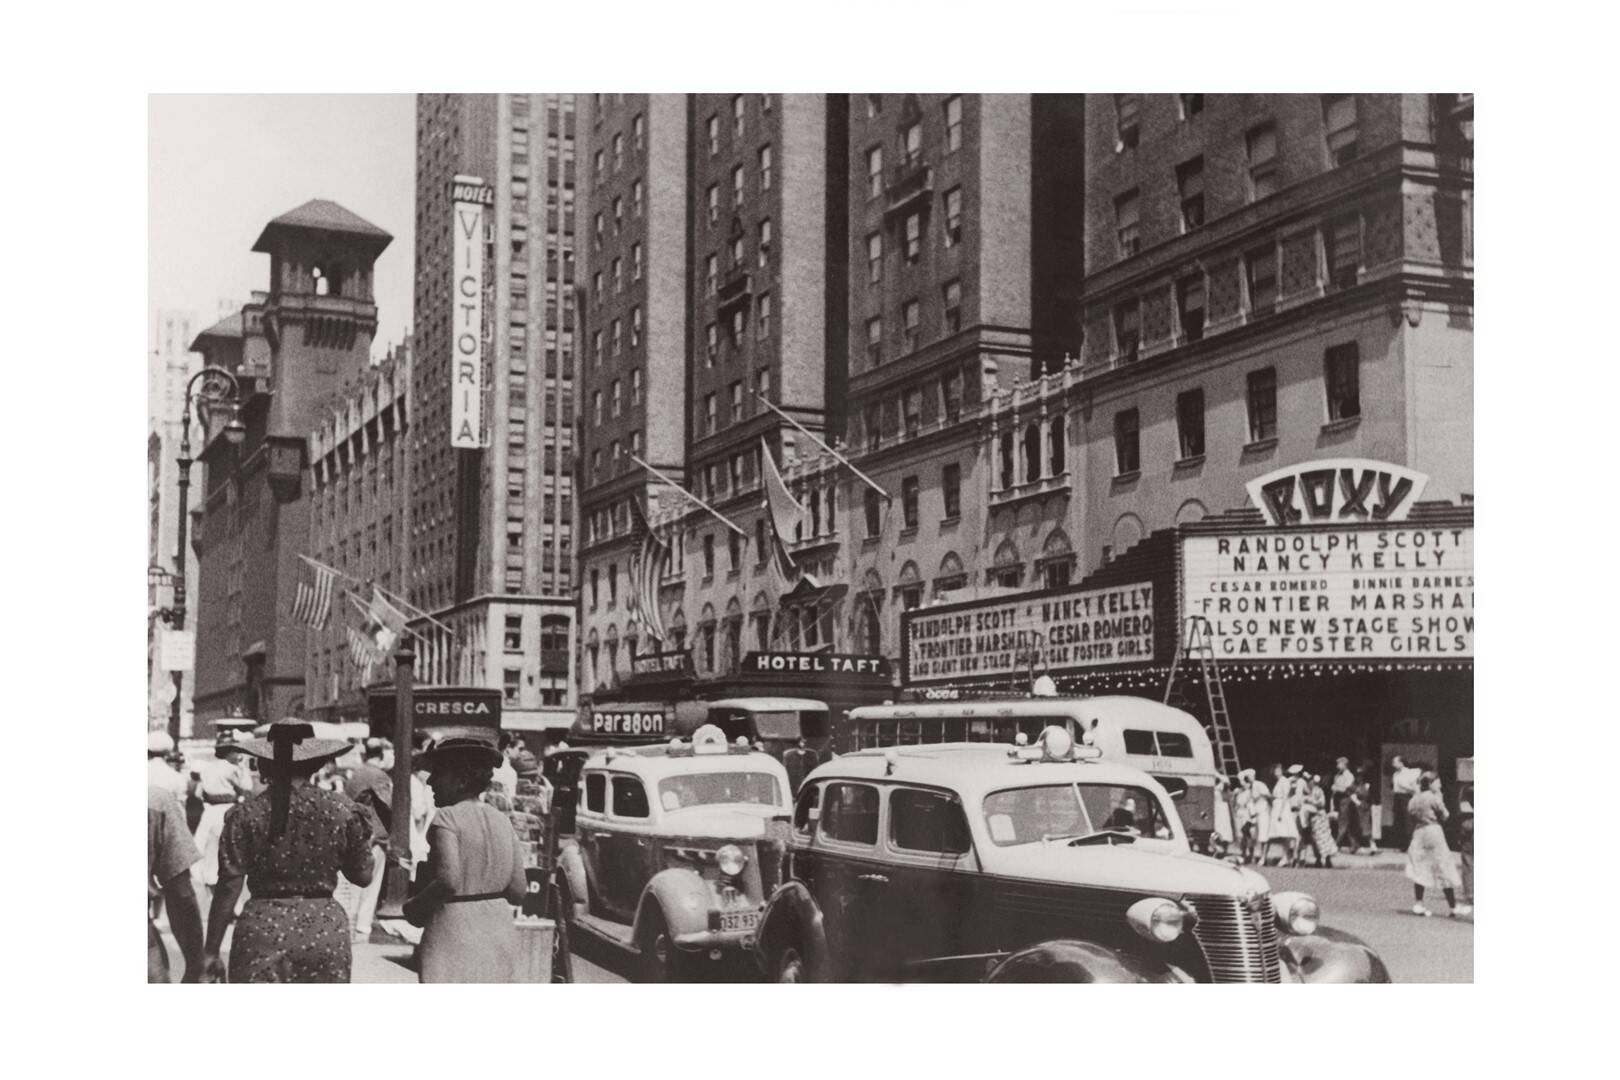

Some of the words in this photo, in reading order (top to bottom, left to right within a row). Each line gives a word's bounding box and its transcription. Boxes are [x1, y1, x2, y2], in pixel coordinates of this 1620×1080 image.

[453, 185, 492, 204] HOTEL
[457, 210, 480, 442] VICTORIA
[1261, 468, 1413, 525] ROXY
[1218, 534, 1358, 555] RANDOLPH
[1377, 531, 1462, 549] SCOTT
[1233, 553, 1330, 572] NANCY
[1351, 550, 1445, 569] KELLY
[1210, 581, 1262, 593] CESAR
[1270, 580, 1328, 592] ROMERO
[1353, 577, 1403, 590] BINNIE
[1412, 576, 1474, 589] BARNES
[1351, 592, 1474, 611] MARSHA
[911, 614, 971, 641] RANDOLPH
[976, 608, 1016, 632] SCOTT
[1042, 597, 1091, 623] NANCY
[1097, 587, 1151, 615] KELLY
[1049, 622, 1089, 645] CESAR
[1094, 614, 1152, 641] ROMERO
[1203, 619, 1258, 636] ALSO
[1269, 618, 1316, 635] NEW
[1328, 616, 1398, 635] STAGE
[1412, 616, 1474, 635] SHOW
[1048, 646, 1069, 663] GAE
[1073, 642, 1113, 661] FOSTER
[1117, 637, 1152, 657] GIRLS
[1223, 638, 1267, 654] GAE
[1281, 636, 1373, 654] FOSTER
[1390, 634, 1466, 653] GIRLS
[662, 653, 685, 670] TAFT
[757, 655, 824, 671] HOTEL
[830, 658, 880, 672] TAFT
[960, 655, 979, 673] NEW
[983, 652, 1011, 670] STAGE
[415, 702, 490, 714] CRESCA
[594, 712, 663, 735] Paragon
